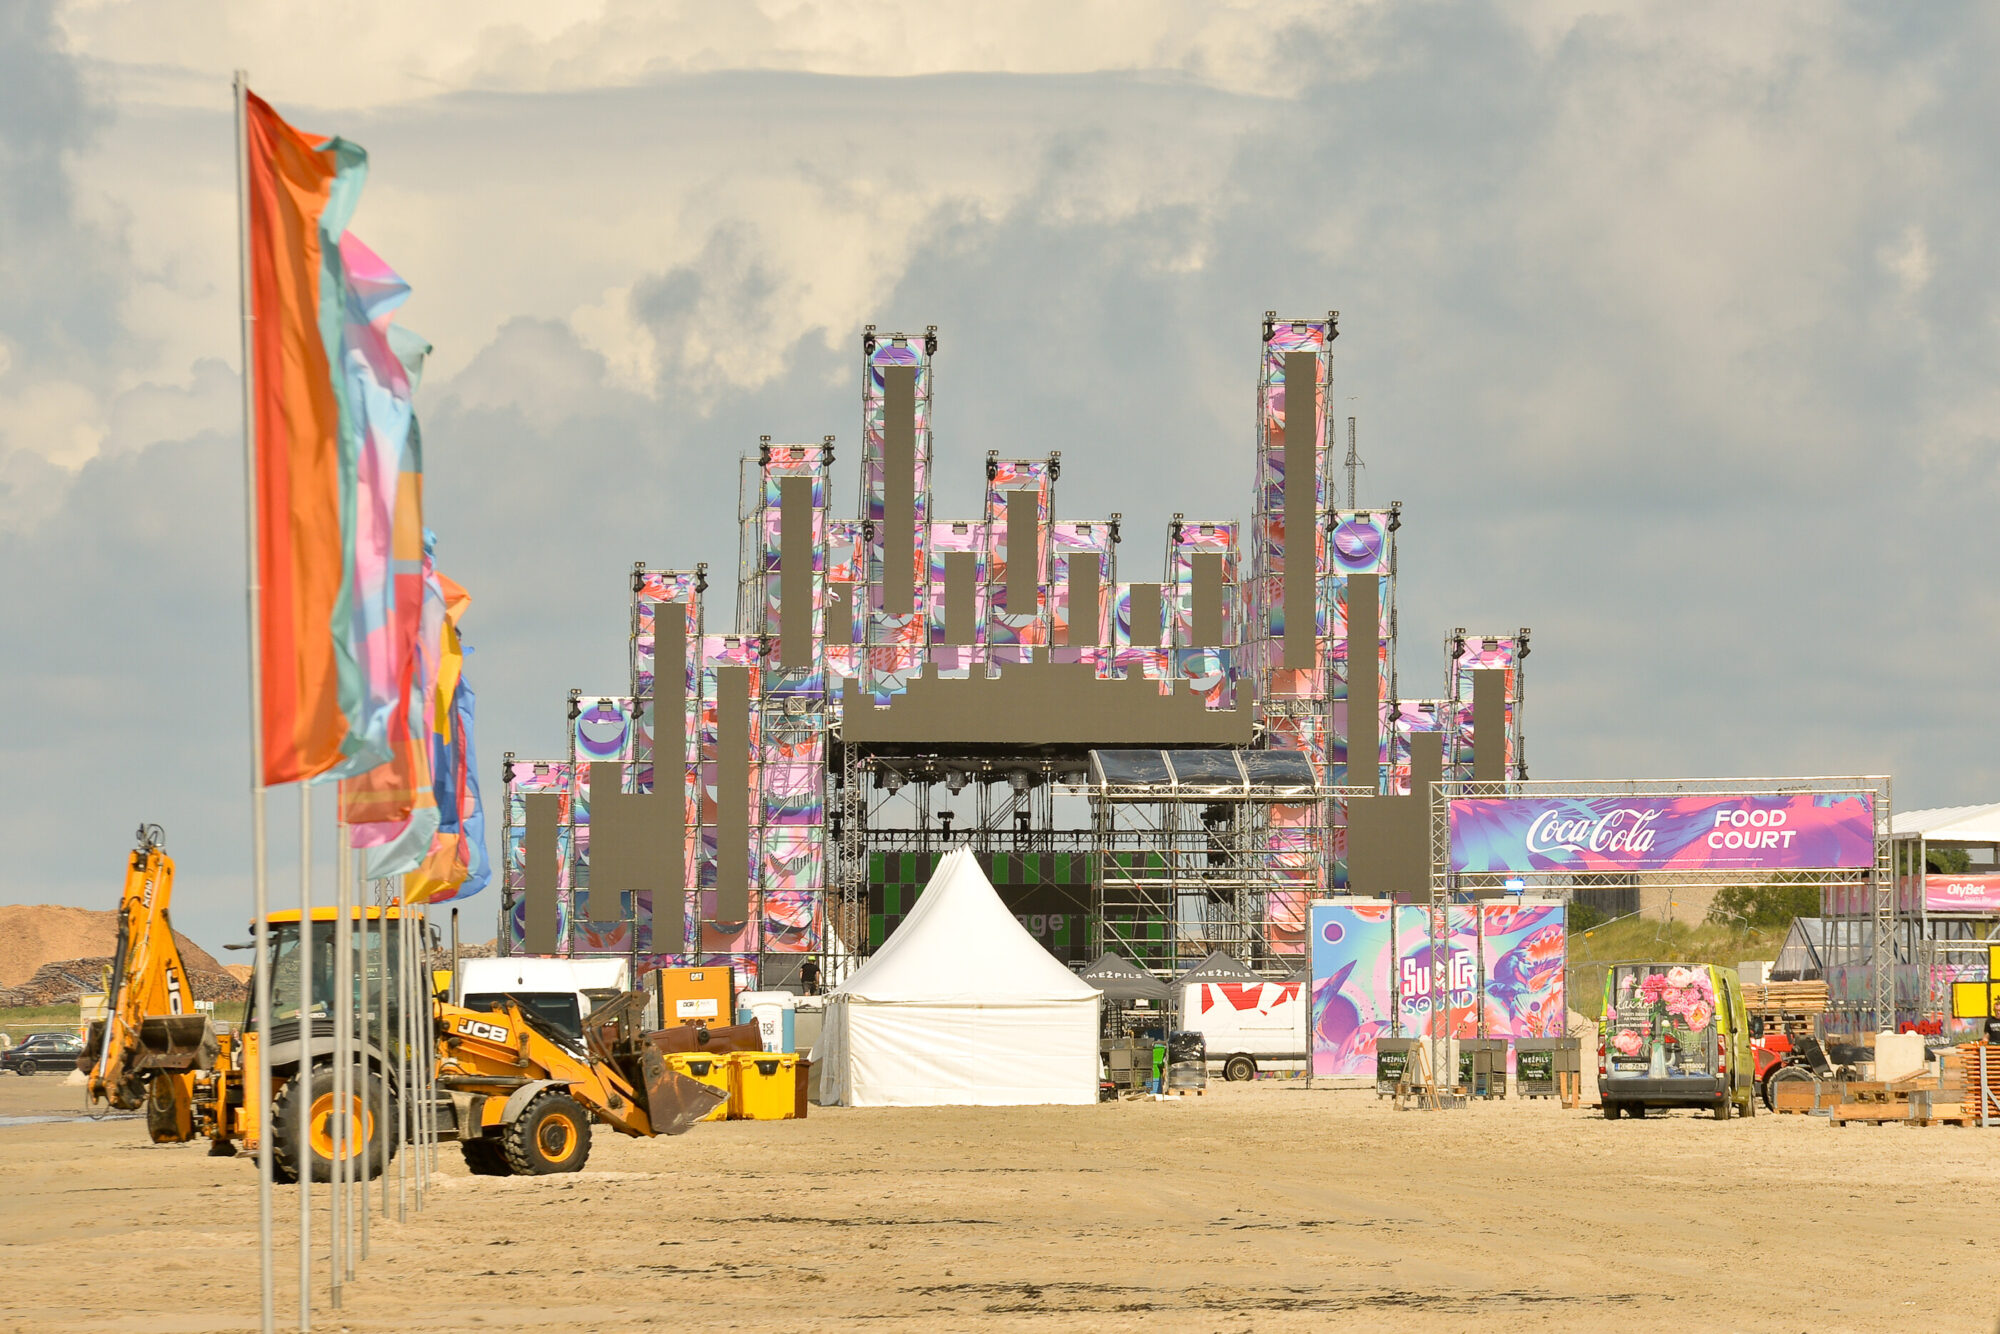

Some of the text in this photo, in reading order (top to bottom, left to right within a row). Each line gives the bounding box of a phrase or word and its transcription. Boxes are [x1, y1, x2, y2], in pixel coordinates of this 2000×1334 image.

[1713, 809, 1787, 828] FOOD
[1525, 808, 1664, 853] Coca-Cola
[1707, 830, 1797, 849] COURT
[1946, 883, 1986, 898] OlyBet
[1086, 971, 1143, 979] MEŽPILS
[1196, 969, 1251, 978] MEŽPILS
[458, 1020, 508, 1042] JCB
[1522, 1055, 1549, 1064] MEŽPILS
